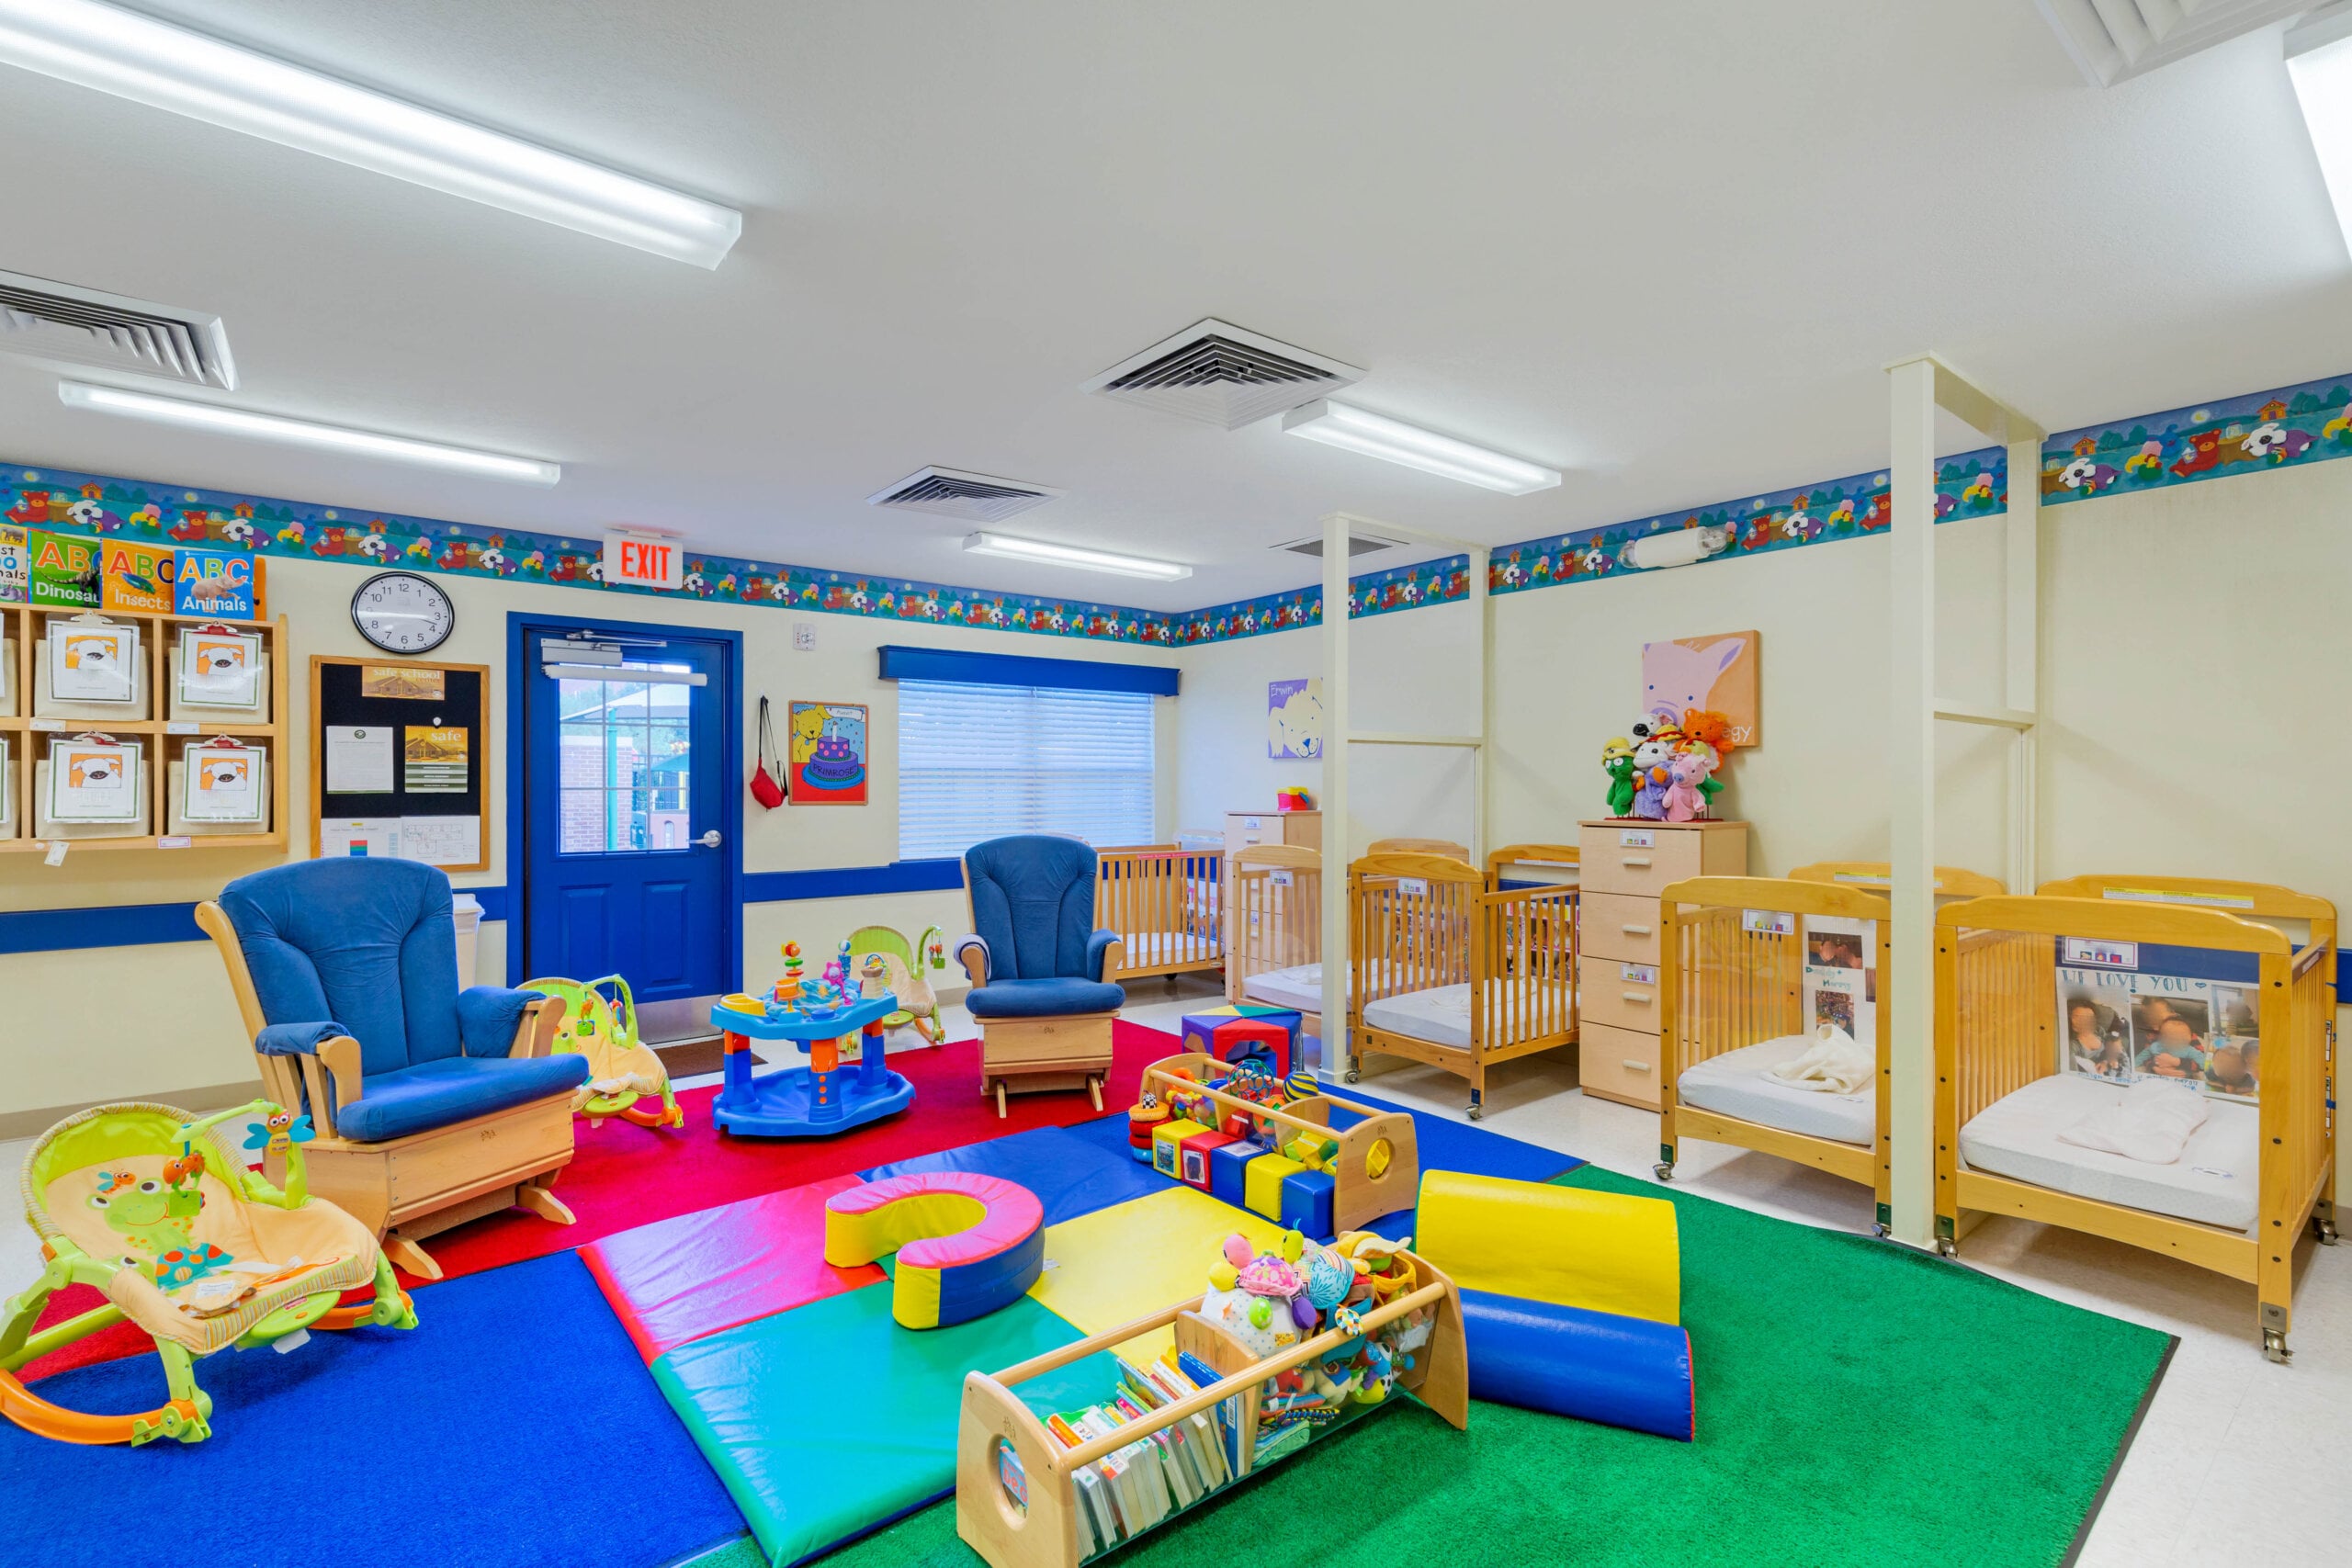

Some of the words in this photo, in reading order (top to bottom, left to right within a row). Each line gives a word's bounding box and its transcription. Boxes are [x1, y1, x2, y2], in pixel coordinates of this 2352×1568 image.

[107, 550, 173, 584] ABC
[621, 541, 672, 581] EXIT
[178, 557, 249, 585] ABC
[382, 586, 391, 595] 11
[398, 583, 410, 592] 12
[115, 588, 171, 612] Insects
[182, 596, 247, 612] Animals
[371, 593, 382, 603] 10
[428, 598, 435, 607] 2
[434, 612, 441, 621] 3
[371, 620, 379, 629] 8
[429, 625, 435, 633] 4
[386, 631, 392, 640] 7
[401, 635, 408, 644] 6
[417, 633, 424, 642] 5
[373, 667, 397, 676] safe
[401, 669, 441, 679] school
[1271, 684, 1294, 697] Erwin
[431, 729, 462, 741] safe
[1721, 726, 1752, 742] egy
[813, 763, 857, 777] PRIMROSE
[2096, 972, 2138, 989] LOVE
[2149, 976, 2189, 992] YOU
